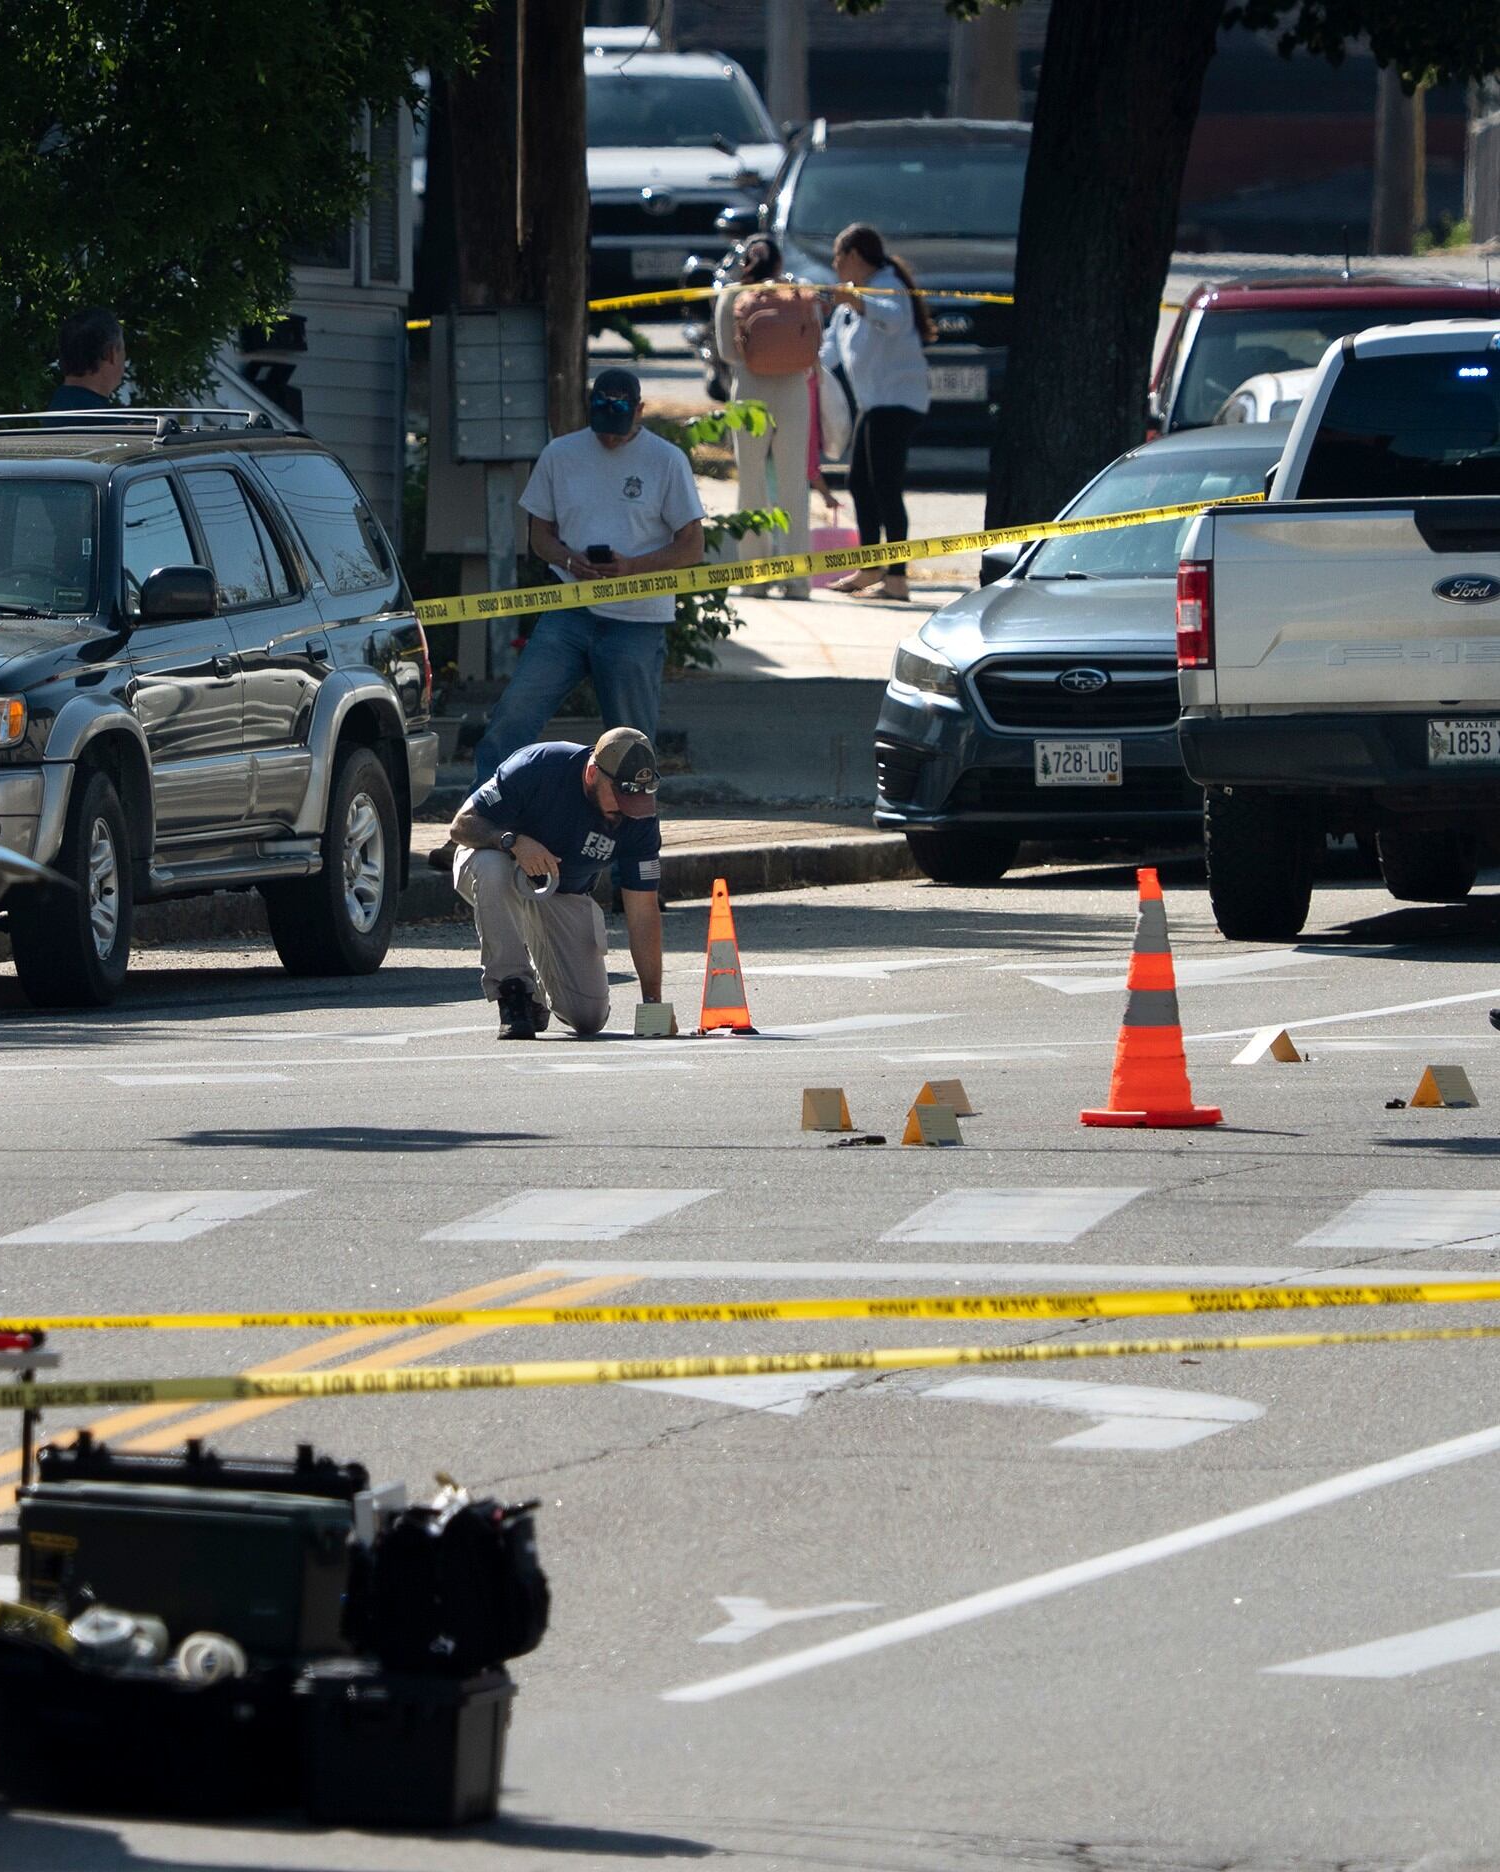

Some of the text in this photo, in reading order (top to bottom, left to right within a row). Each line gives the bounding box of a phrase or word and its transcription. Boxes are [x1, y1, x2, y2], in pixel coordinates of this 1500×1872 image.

[964, 536, 977, 549] NOT
[978, 535, 988, 547] DO
[990, 532, 1003, 545] LINE
[1004, 529, 1027, 542] POLICE
[825, 545, 910, 568] POLICE LINE DO NOT CROSS
[708, 560, 794, 584] POLICE LINE DO NOT CROSS
[592, 576, 677, 599] POLICE LINE DO NOT CROSS
[1449, 580, 1492, 598] Ford
[477, 590, 562, 613] POLICE LINE DO NOT CROSS
[425, 604, 448, 618] POLICE
[1455, 721, 1497, 729] MAINE
[1448, 730, 1491, 755] 1853
[584, 831, 616, 853] FBI
